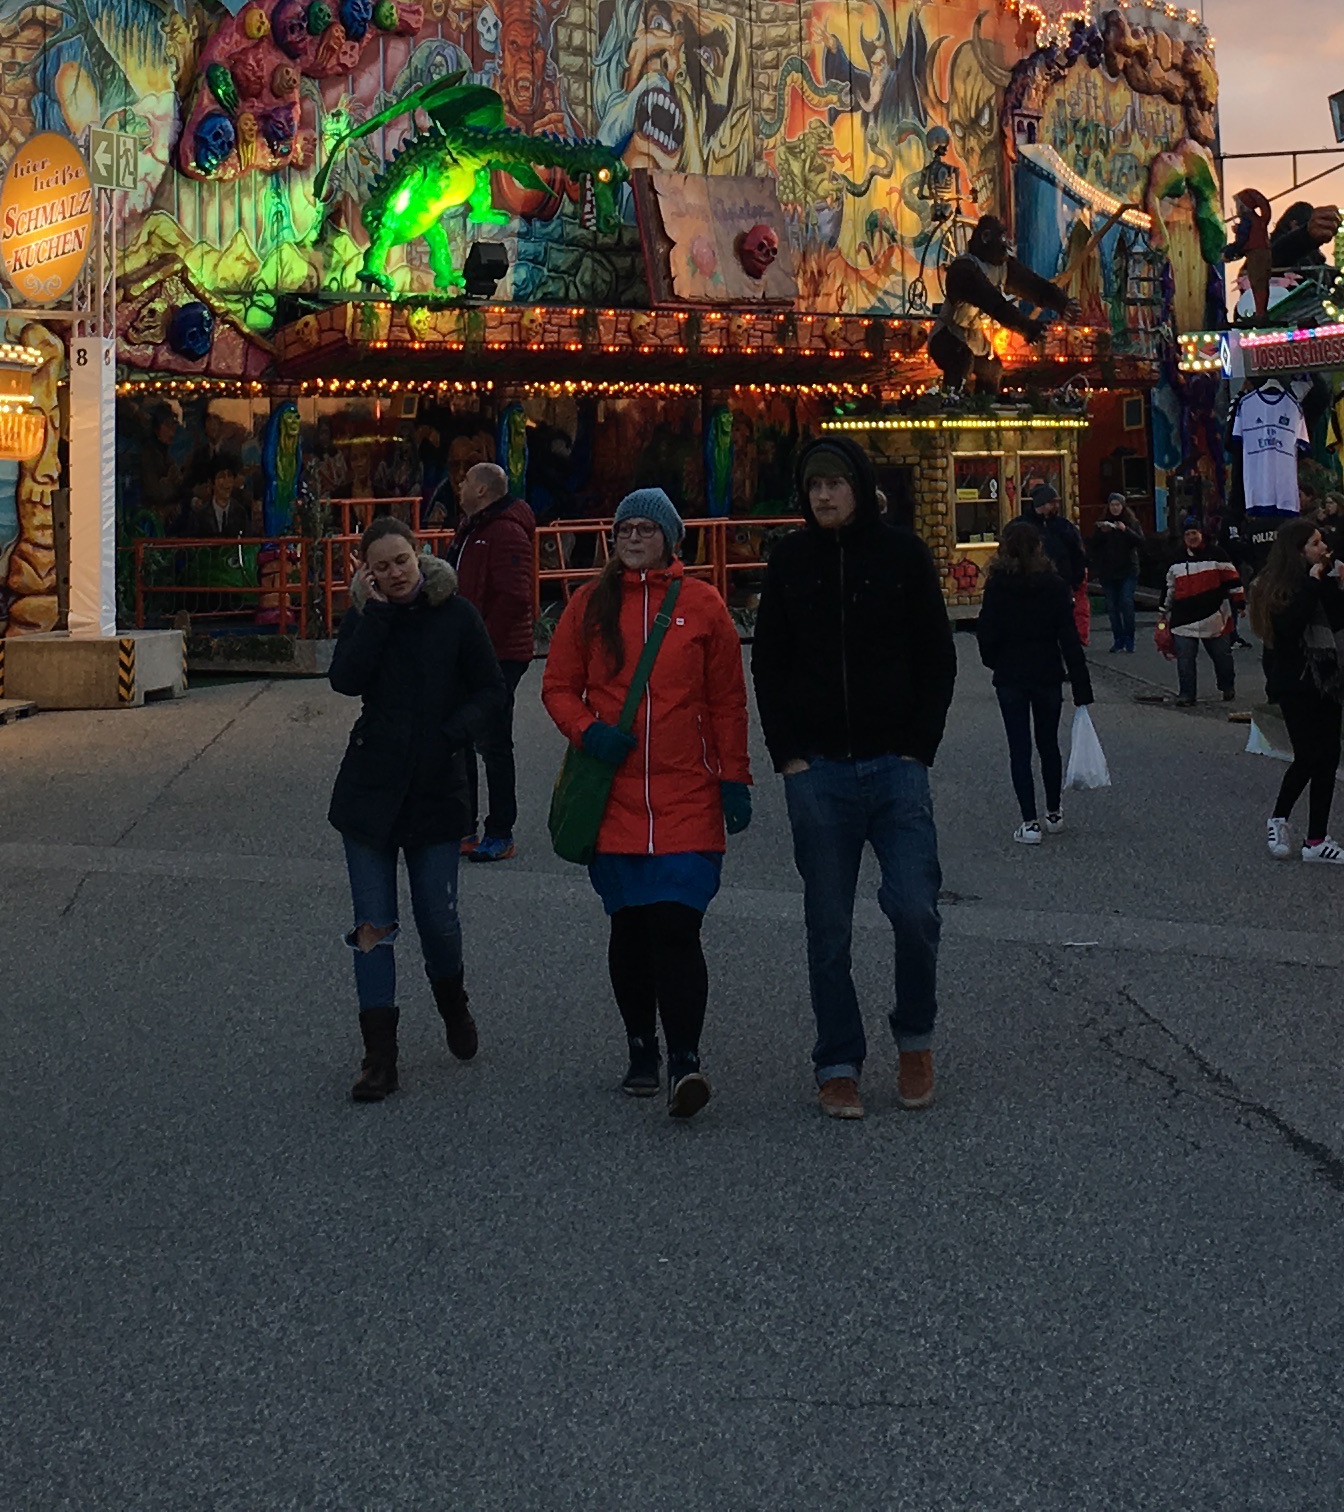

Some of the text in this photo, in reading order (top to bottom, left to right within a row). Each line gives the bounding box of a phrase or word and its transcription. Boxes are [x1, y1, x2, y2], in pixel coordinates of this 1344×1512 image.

[13, 158, 51, 179] hier
[34, 165, 85, 192] heiße
[2, 189, 92, 241] SCHMALZ
[6, 226, 87, 274] -KUCHEN
[76, 348, 88, 367] 8
